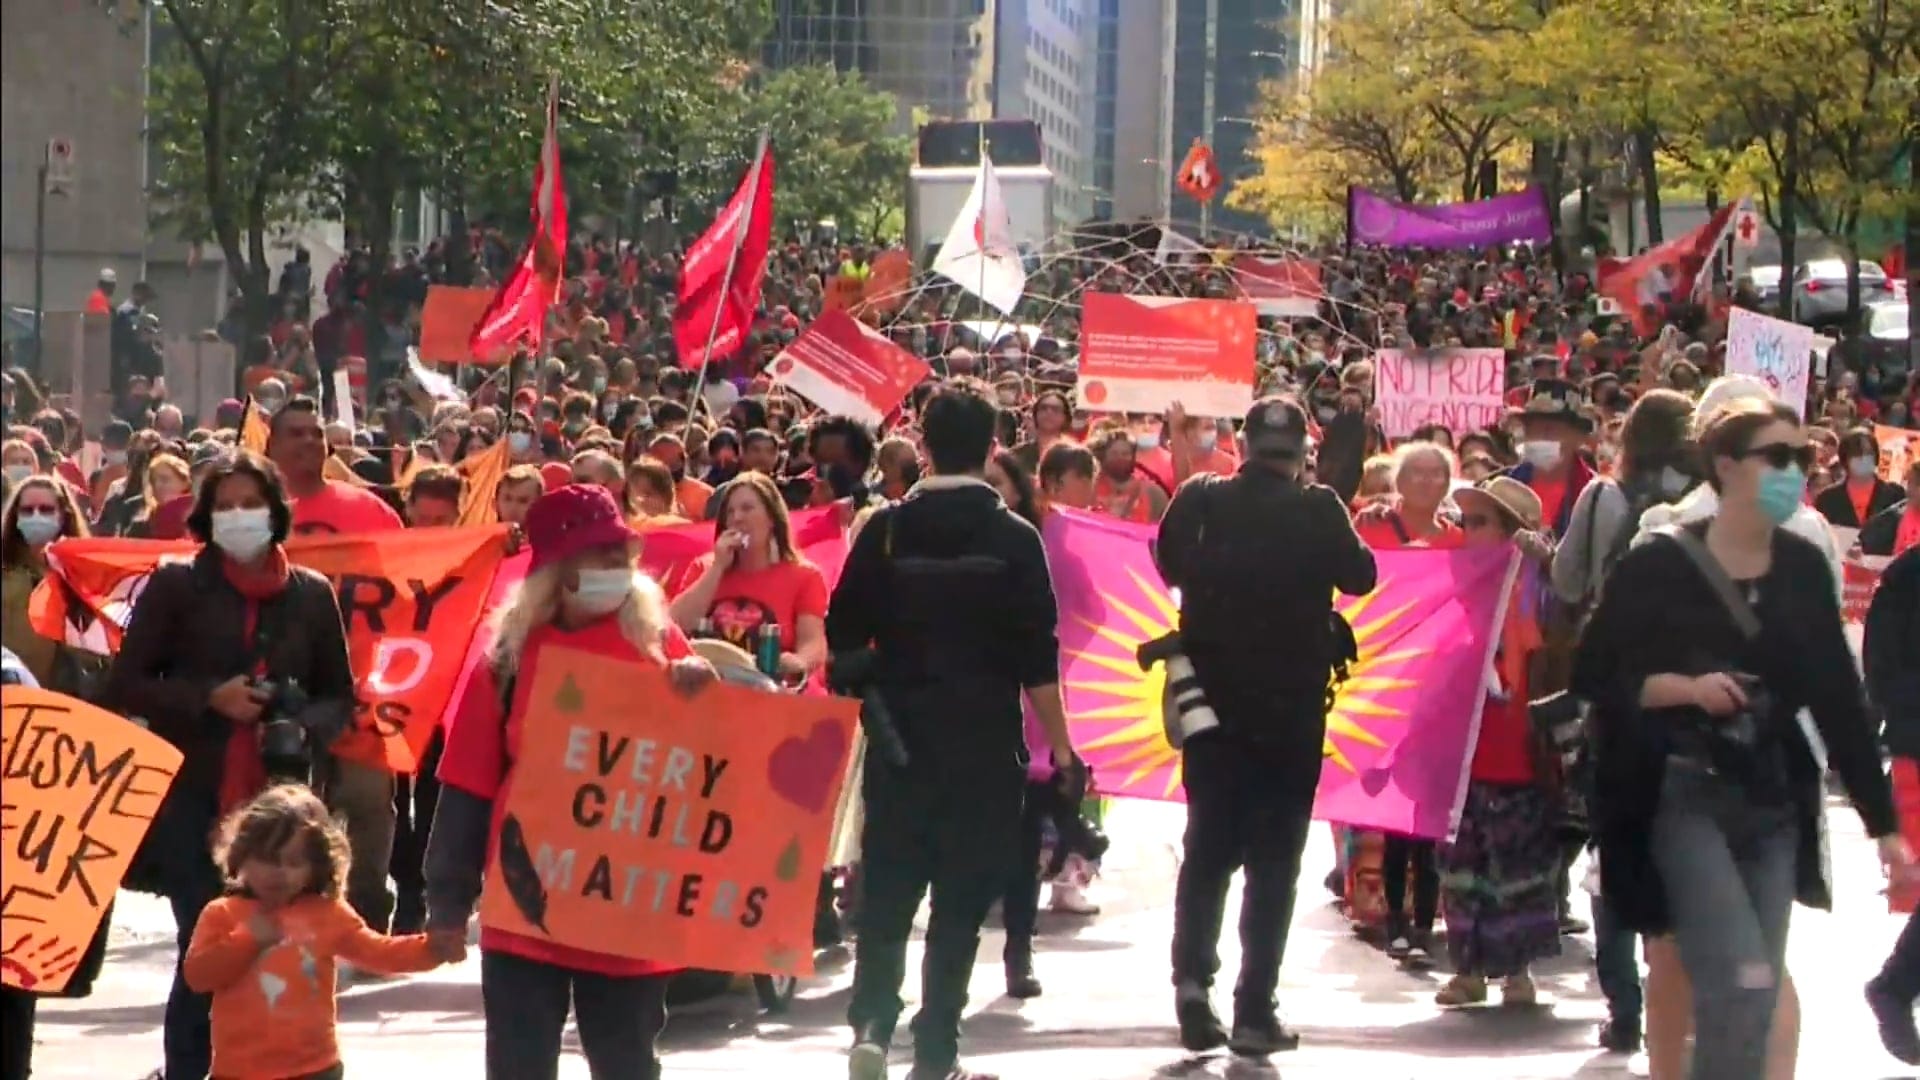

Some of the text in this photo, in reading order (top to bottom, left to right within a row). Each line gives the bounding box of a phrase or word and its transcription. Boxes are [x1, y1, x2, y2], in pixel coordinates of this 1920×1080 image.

[1379, 353, 1503, 396] NO PRIDE
[2, 703, 174, 831] TISME
[564, 726, 728, 799] EVERY
[572, 783, 733, 854] CHILD
[533, 842, 769, 928] MATTERS
